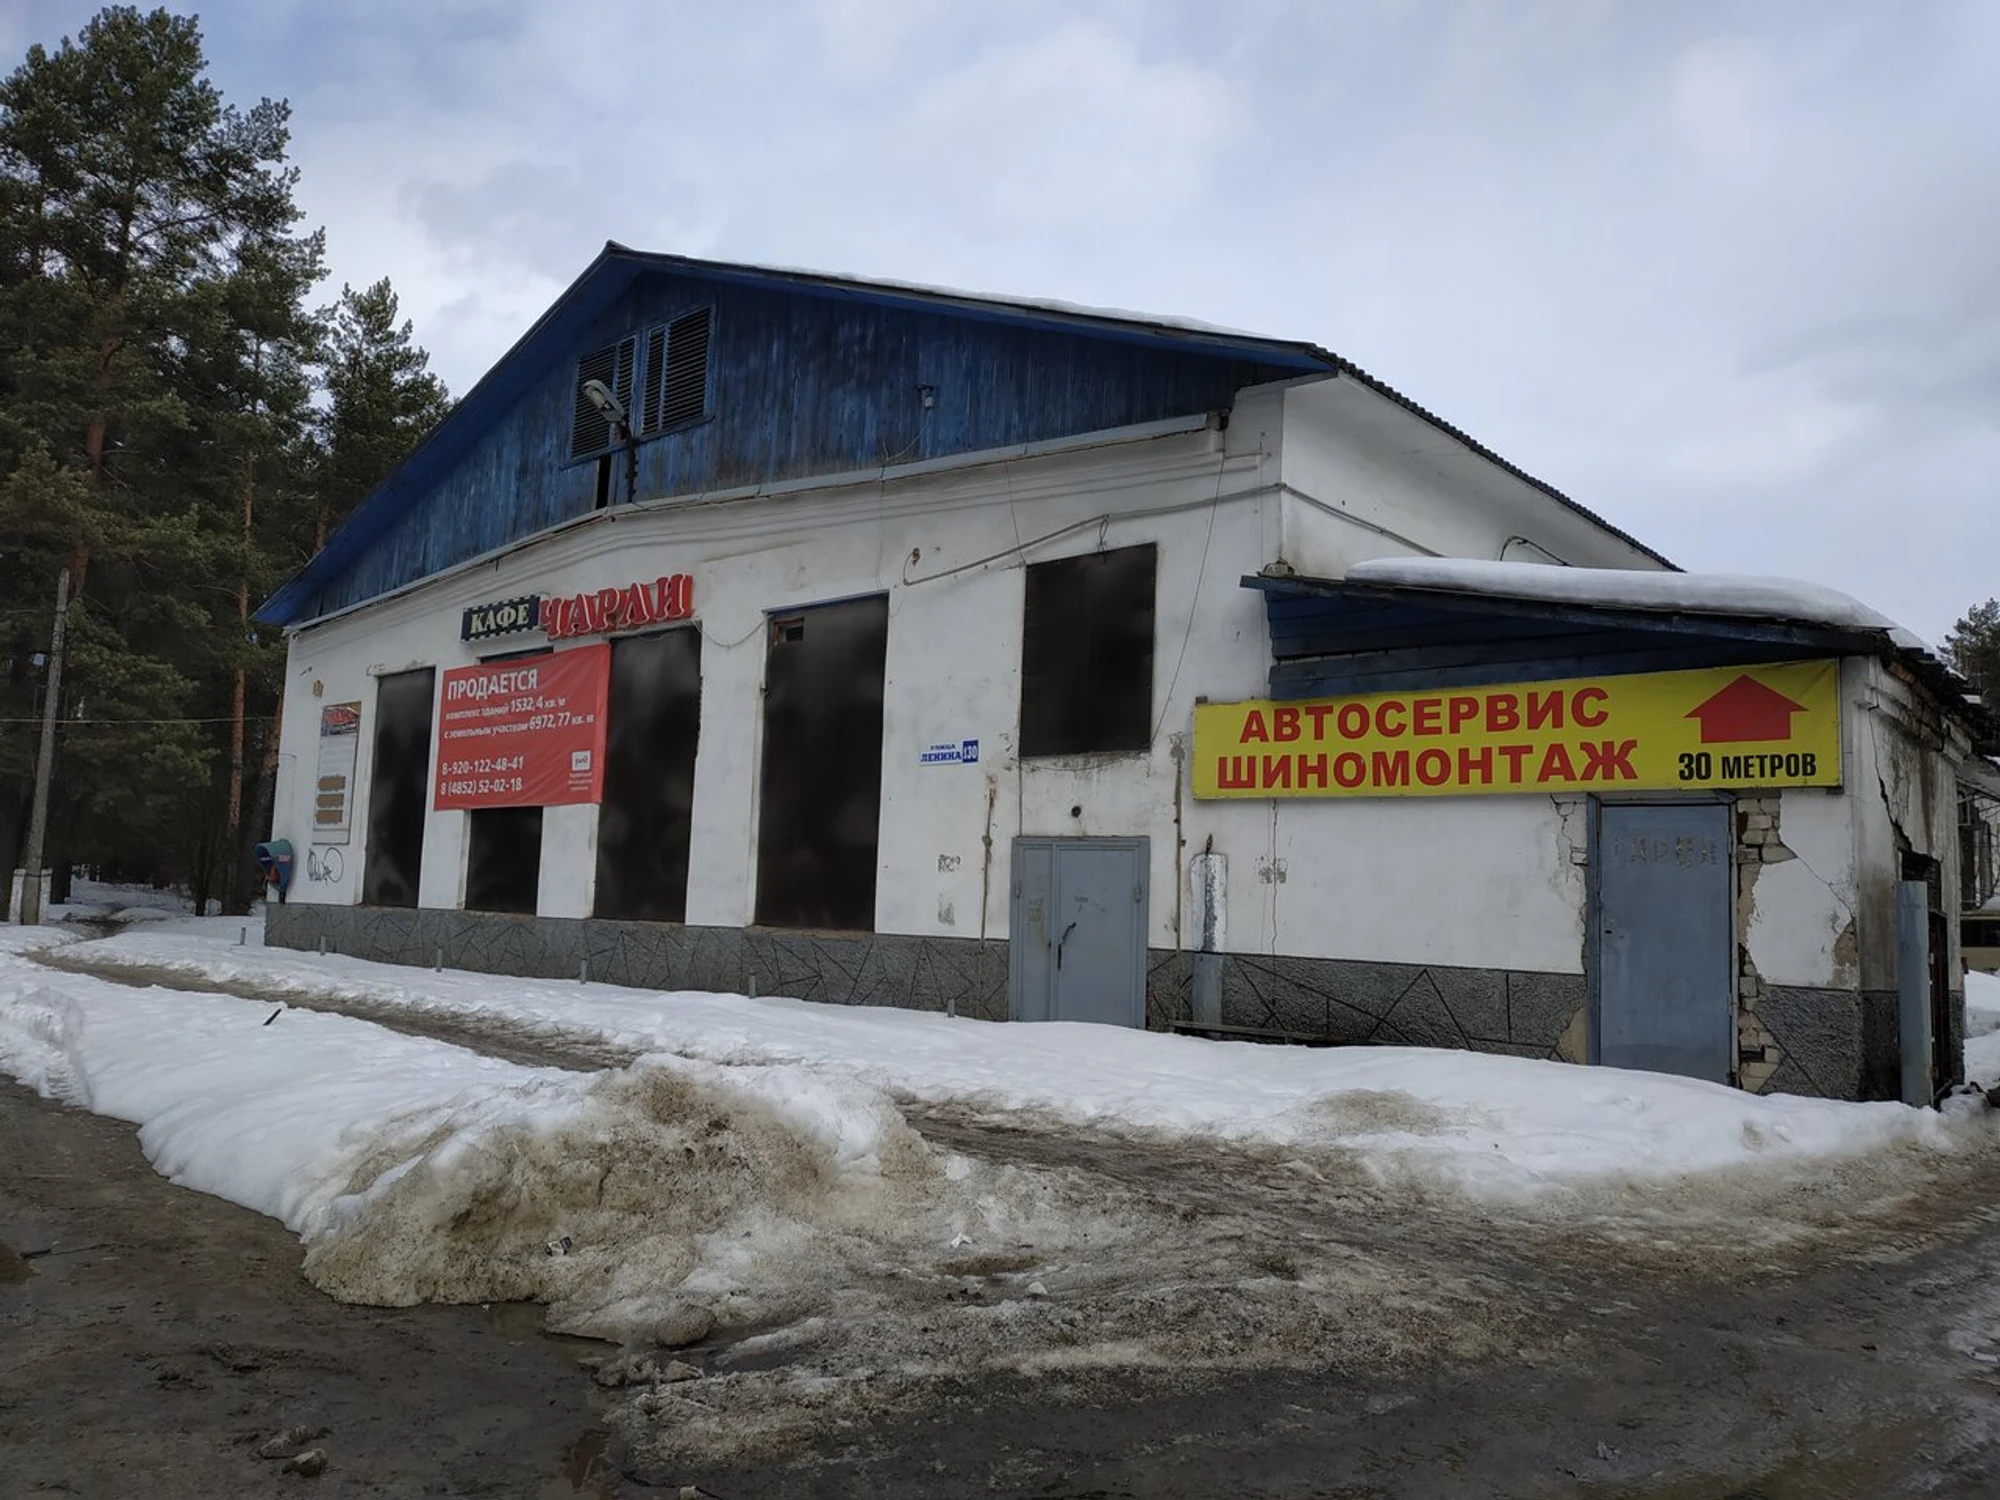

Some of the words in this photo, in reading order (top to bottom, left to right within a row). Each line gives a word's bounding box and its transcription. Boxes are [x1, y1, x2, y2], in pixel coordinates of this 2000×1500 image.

[470, 603, 530, 635] КАФЕ
[539, 573, 693, 639] ЧАРЛИ
[447, 668, 538, 700] ПРОДАЕТСЯ
[557, 697, 566, 706] м
[585, 714, 595, 723] м
[1239, 687, 1609, 744] АВТОСЕРВИС
[442, 755, 524, 776] 8-920-122-48-41
[920, 751, 962, 762] ЛЕНИНА
[1217, 739, 1639, 789] ШИНОМОНТАЖ
[1678, 752, 1712, 781] 30
[1721, 753, 1817, 780] МЕТРОВ
[440, 782, 448, 796] 8
[448, 779, 477, 797] (4852)
[478, 777, 523, 794] 52-02-18
